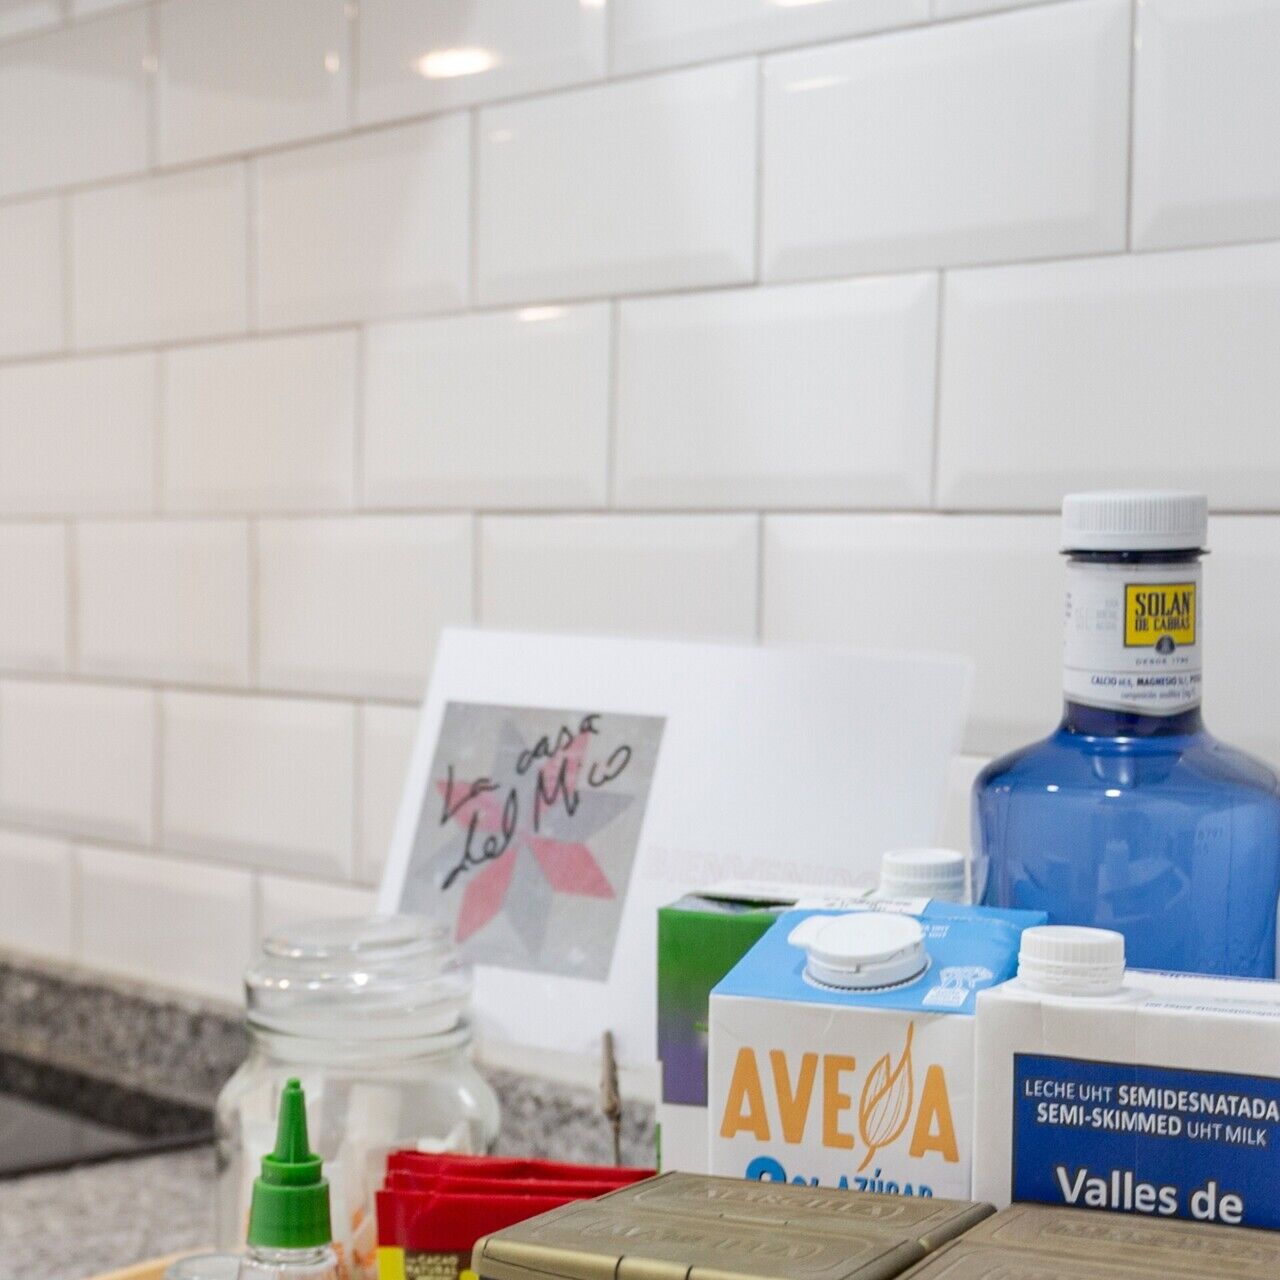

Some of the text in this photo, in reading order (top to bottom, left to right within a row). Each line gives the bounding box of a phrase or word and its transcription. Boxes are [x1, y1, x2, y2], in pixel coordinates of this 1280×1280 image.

[1135, 592, 1191, 617] SOLAN
[1135, 616, 1190, 632] DE CABRAS
[440, 763, 500, 826] La
[1024, 1079, 1280, 1123] LECHE UHT SEMIDESNATADA
[1036, 1102, 1268, 1147] SEMI-SKIMMED UHT MILK
[1055, 1166, 1244, 1225] Valles de
